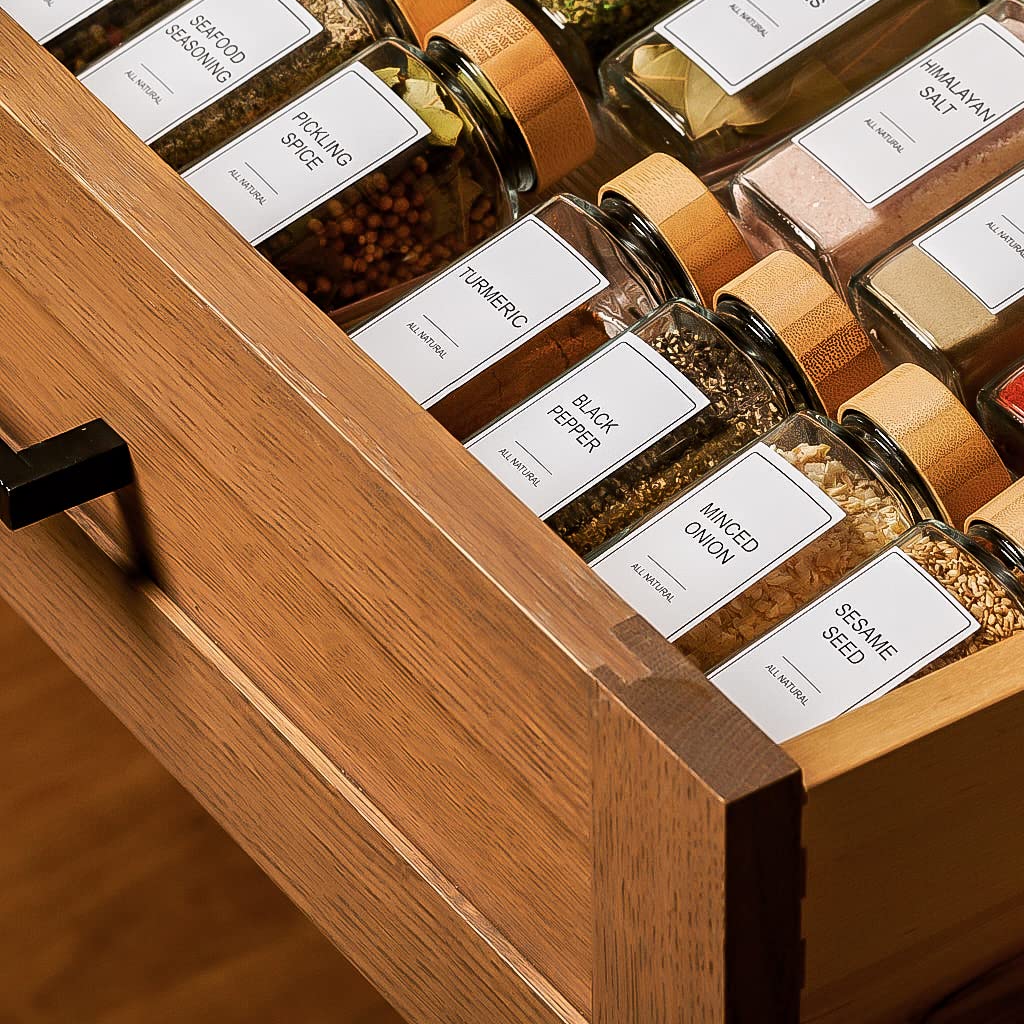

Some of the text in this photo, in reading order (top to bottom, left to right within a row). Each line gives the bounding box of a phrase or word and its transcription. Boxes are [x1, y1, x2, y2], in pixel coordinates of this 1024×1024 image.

[165, 24, 232, 84] SEASONING
[190, 15, 246, 64] SEAFOOD
[124, 70, 163, 105] ALL NATURAL
[919, 86, 957, 116] SALT
[920, 58, 996, 123] HIMALAYAN
[281, 133, 324, 171] SPICE
[292, 111, 352, 167] PICKLING
[864, 118, 905, 154] ALL NATURAL
[228, 169, 268, 206] ALL NATURAL
[985, 220, 999, 235] ALL
[459, 266, 528, 329] TURMERIC
[406, 321, 448, 359] ALL NATURAL
[547, 405, 601, 454] PEPPER
[572, 394, 620, 434] BLACK
[498, 447, 541, 487] ALL NATURAL
[684, 521, 736, 565] ONION
[699, 502, 759, 553] MINCED
[630, 562, 675, 603] ALL NATURAL
[822, 626, 865, 665] SEED
[835, 603, 899, 662] SESAME
[765, 664, 809, 706] ALL NATURAL
